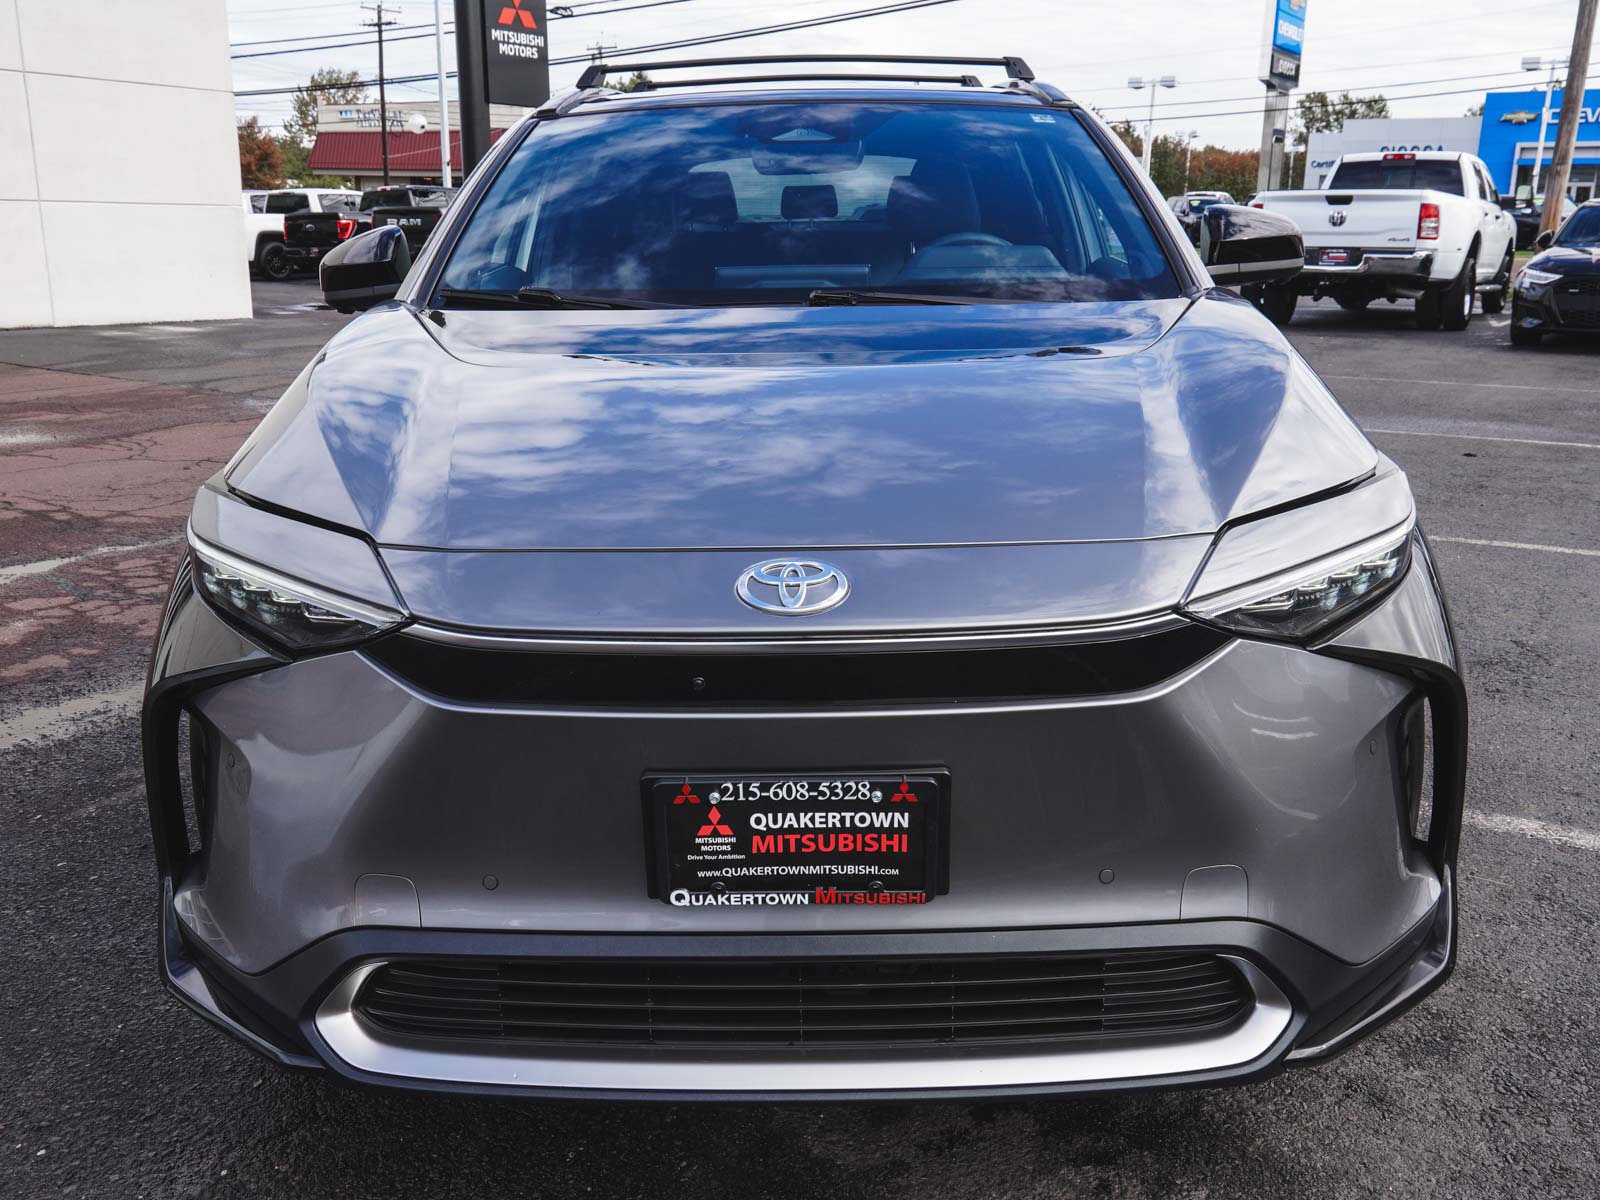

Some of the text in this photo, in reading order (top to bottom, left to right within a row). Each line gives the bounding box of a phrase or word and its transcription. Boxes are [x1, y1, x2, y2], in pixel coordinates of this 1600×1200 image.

[491, 29, 545, 47] MITSUBISHI
[499, 42, 538, 59] MOTORS
[387, 218, 422, 226] RAM
[721, 781, 871, 801] 215-608-5328
[749, 812, 909, 830] QUAKERTOWN
[751, 833, 908, 854] MITSUBISHI
[669, 886, 926, 907] QUAKERTOWN MITSUBISHI
